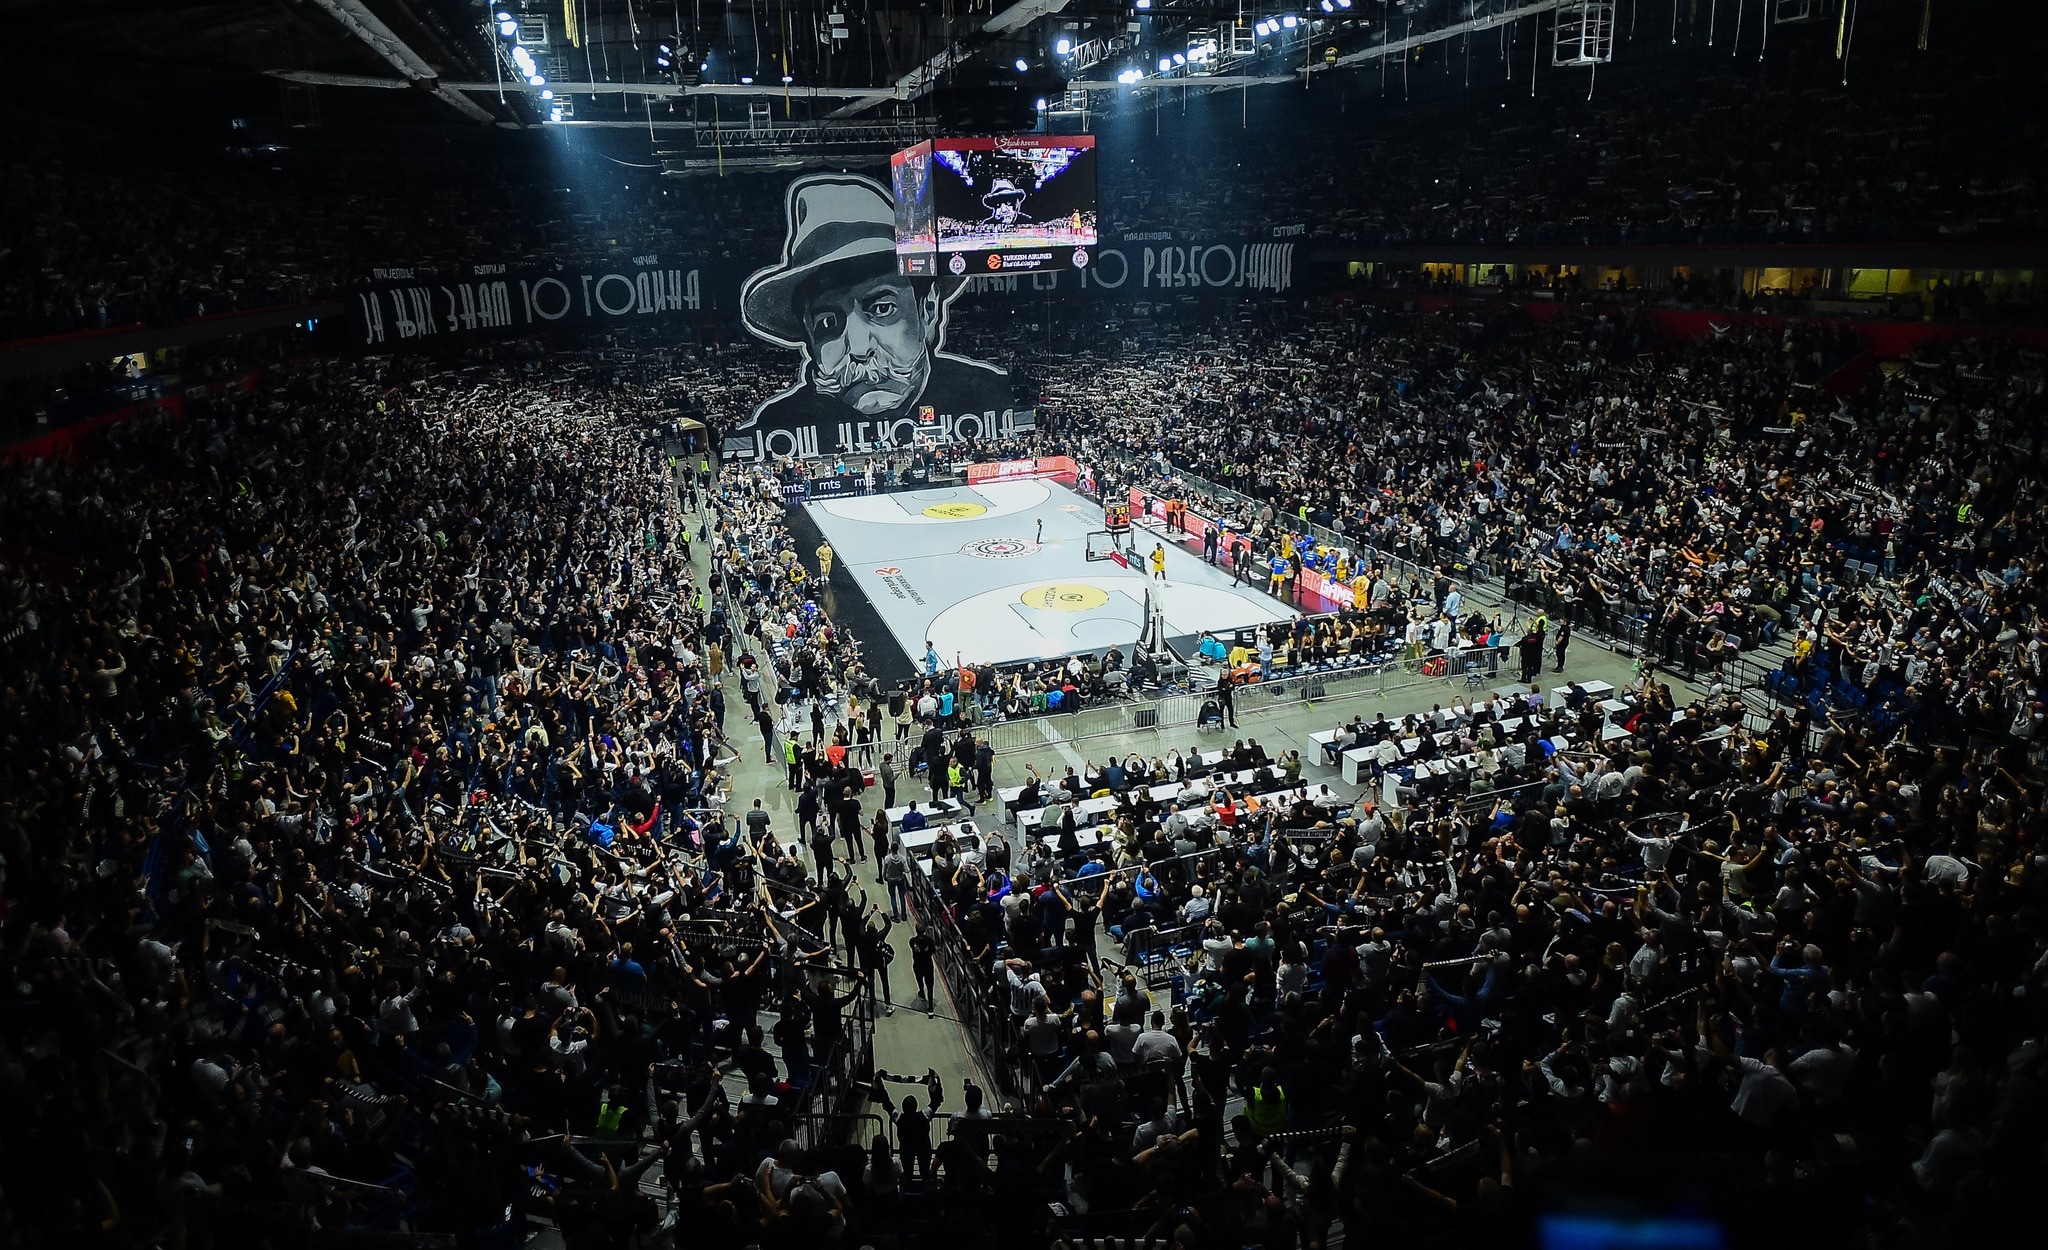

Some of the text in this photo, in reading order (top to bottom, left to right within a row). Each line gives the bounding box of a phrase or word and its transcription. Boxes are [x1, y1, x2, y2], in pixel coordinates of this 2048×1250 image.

[632, 255, 658, 266] ЧАЧАК
[580, 270, 700, 316] ГОДИНА
[754, 425, 819, 461] ЈОШ
[819, 479, 841, 491] mts
[854, 477, 876, 488] ms
[782, 483, 805, 494] mts
[1118, 515, 1130, 525] 24
[1128, 554, 1142, 568] mts
